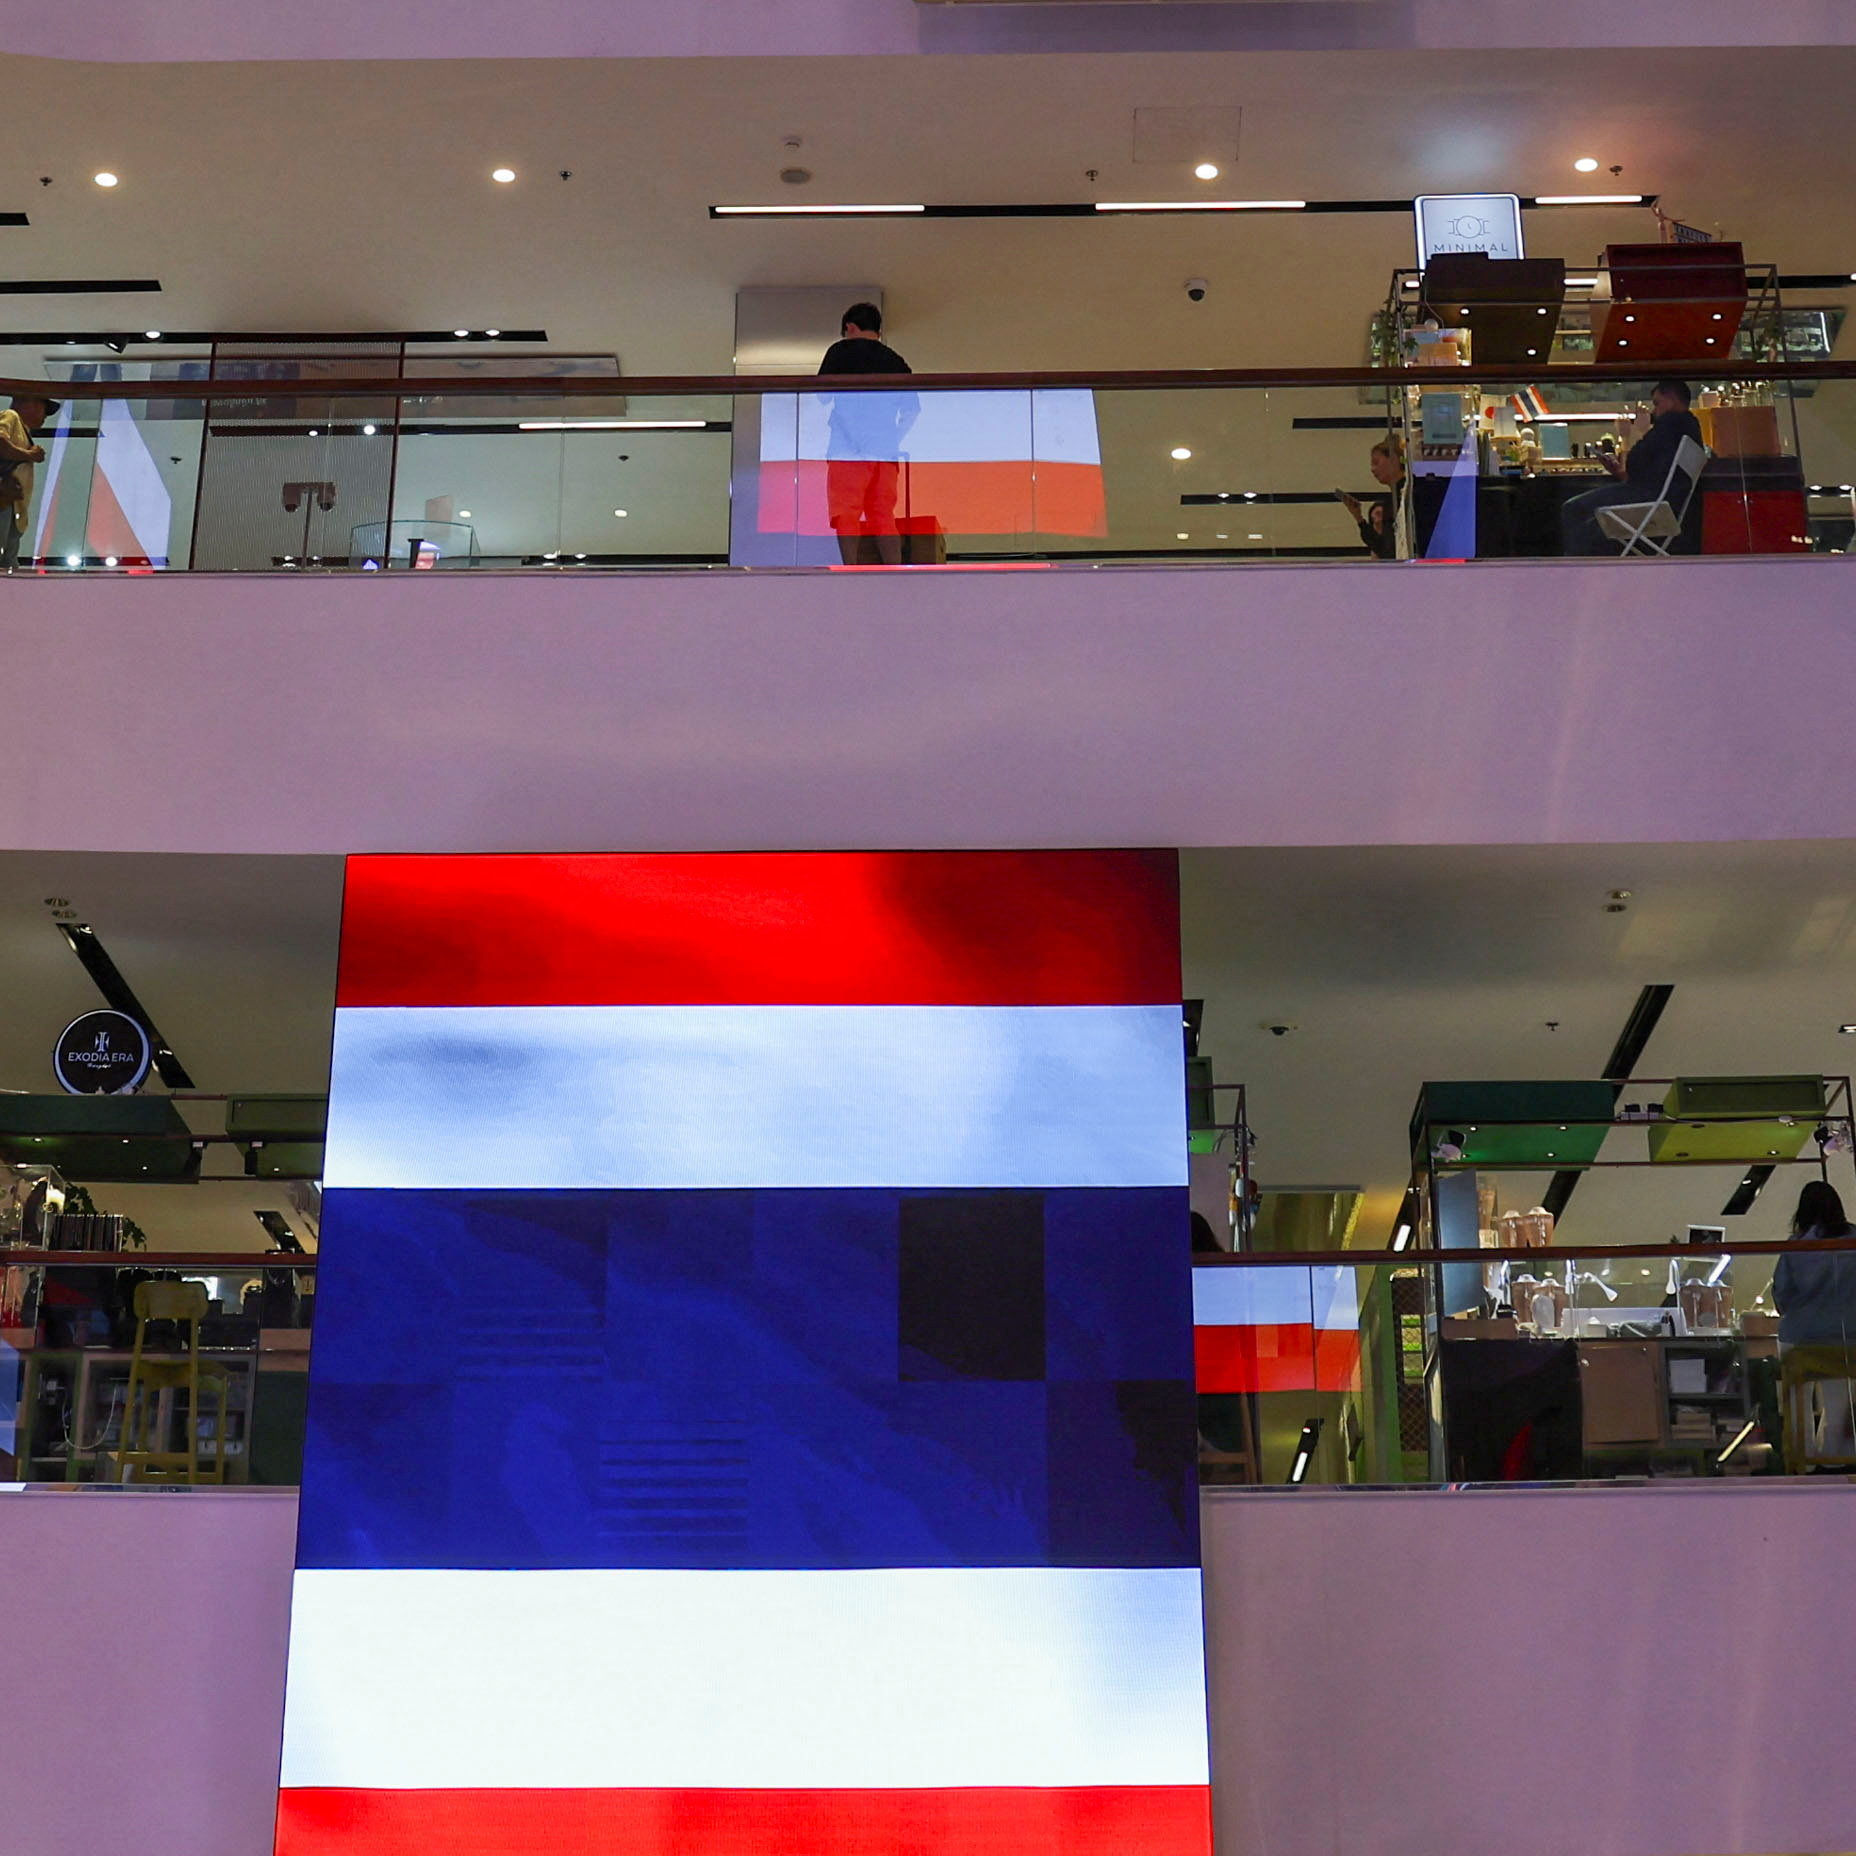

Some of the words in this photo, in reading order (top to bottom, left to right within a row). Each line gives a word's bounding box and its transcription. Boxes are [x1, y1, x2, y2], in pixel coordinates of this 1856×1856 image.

[1433, 243, 1509, 253] MINIMAL
[67, 1051, 110, 1062] EXODIA
[111, 1052, 135, 1062] ERA
